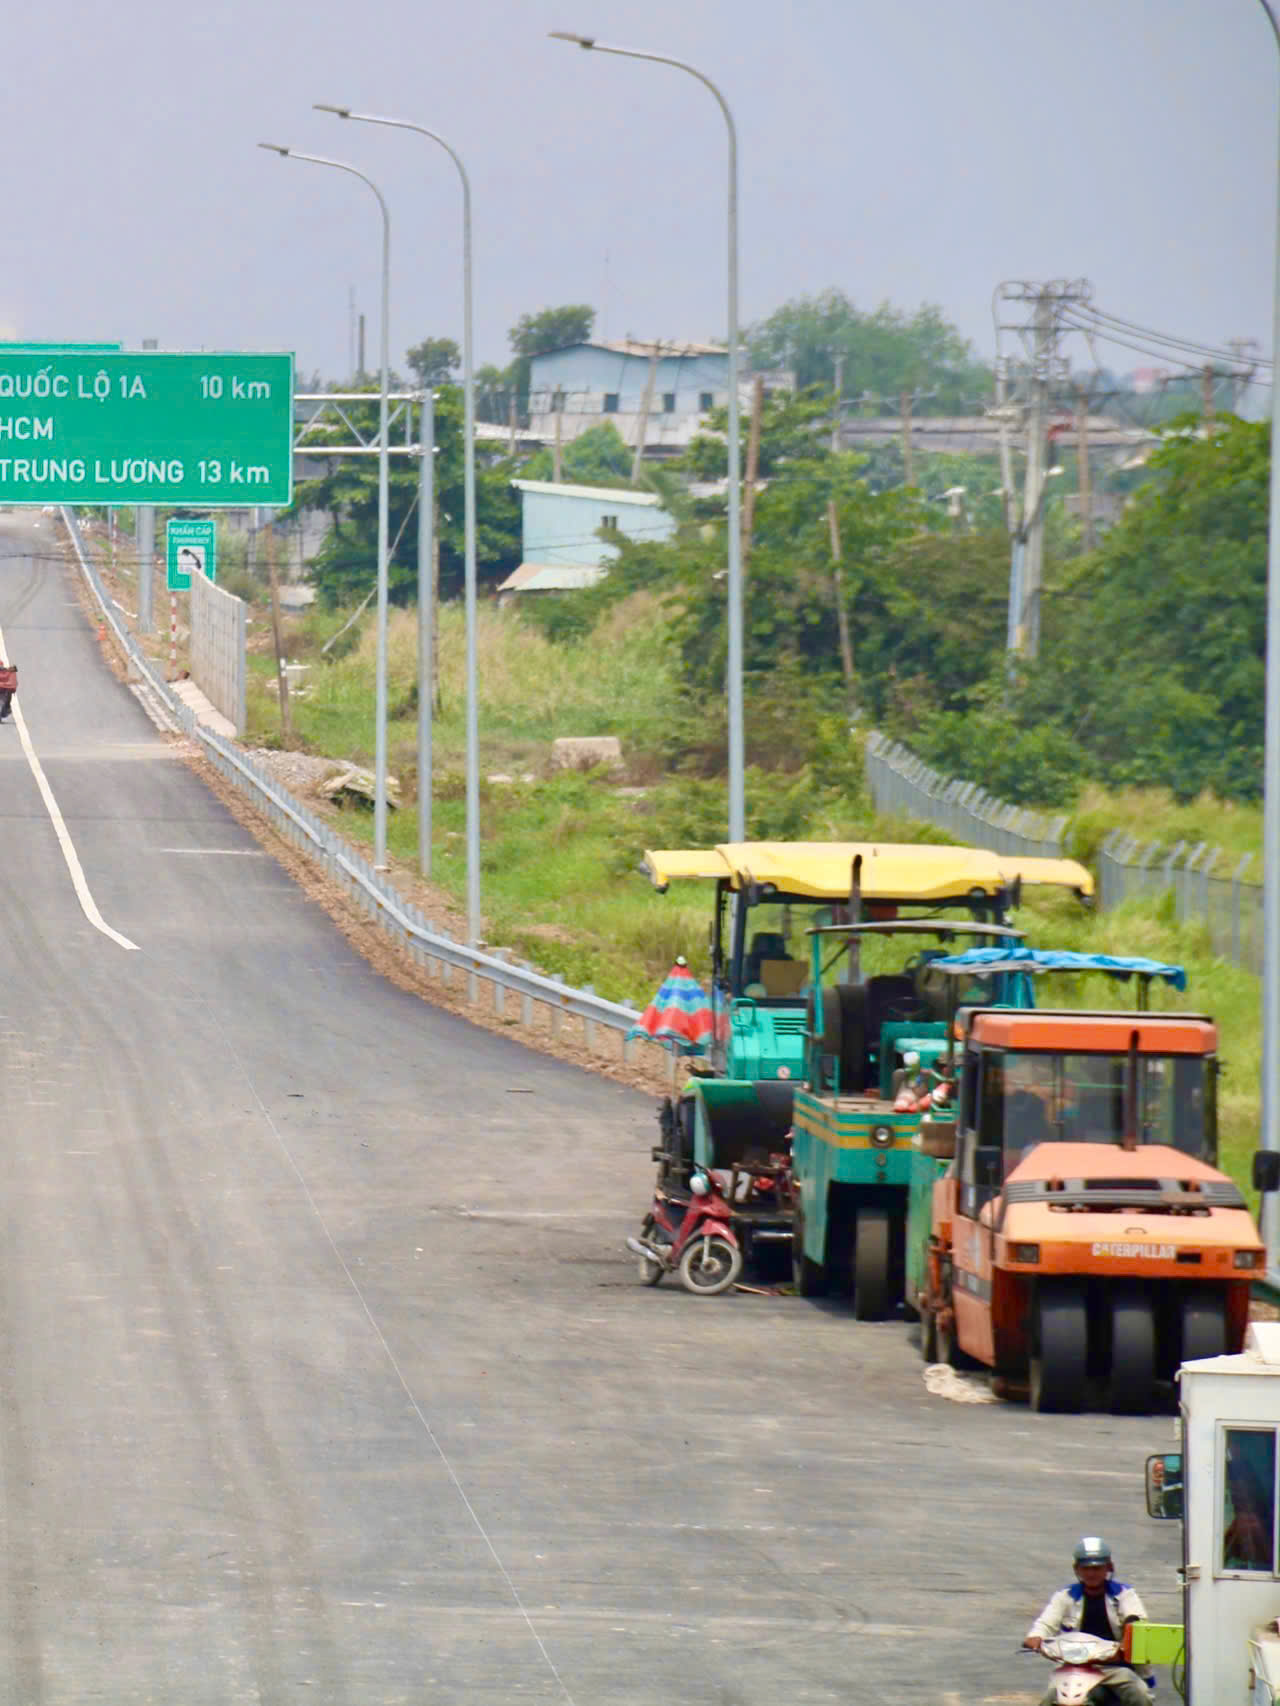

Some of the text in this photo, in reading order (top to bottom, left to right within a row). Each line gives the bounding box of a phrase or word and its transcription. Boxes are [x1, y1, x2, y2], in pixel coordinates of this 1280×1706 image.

[77, 369, 111, 402] LỘ
[119, 375, 147, 399] 1A
[199, 375, 223, 399] 10
[232, 376, 271, 399] km
[95, 458, 184, 483] LƯƠNG
[198, 460, 221, 483] 13
[230, 461, 270, 484] km
[1091, 1241, 1177, 1259] CATERPILLAR
